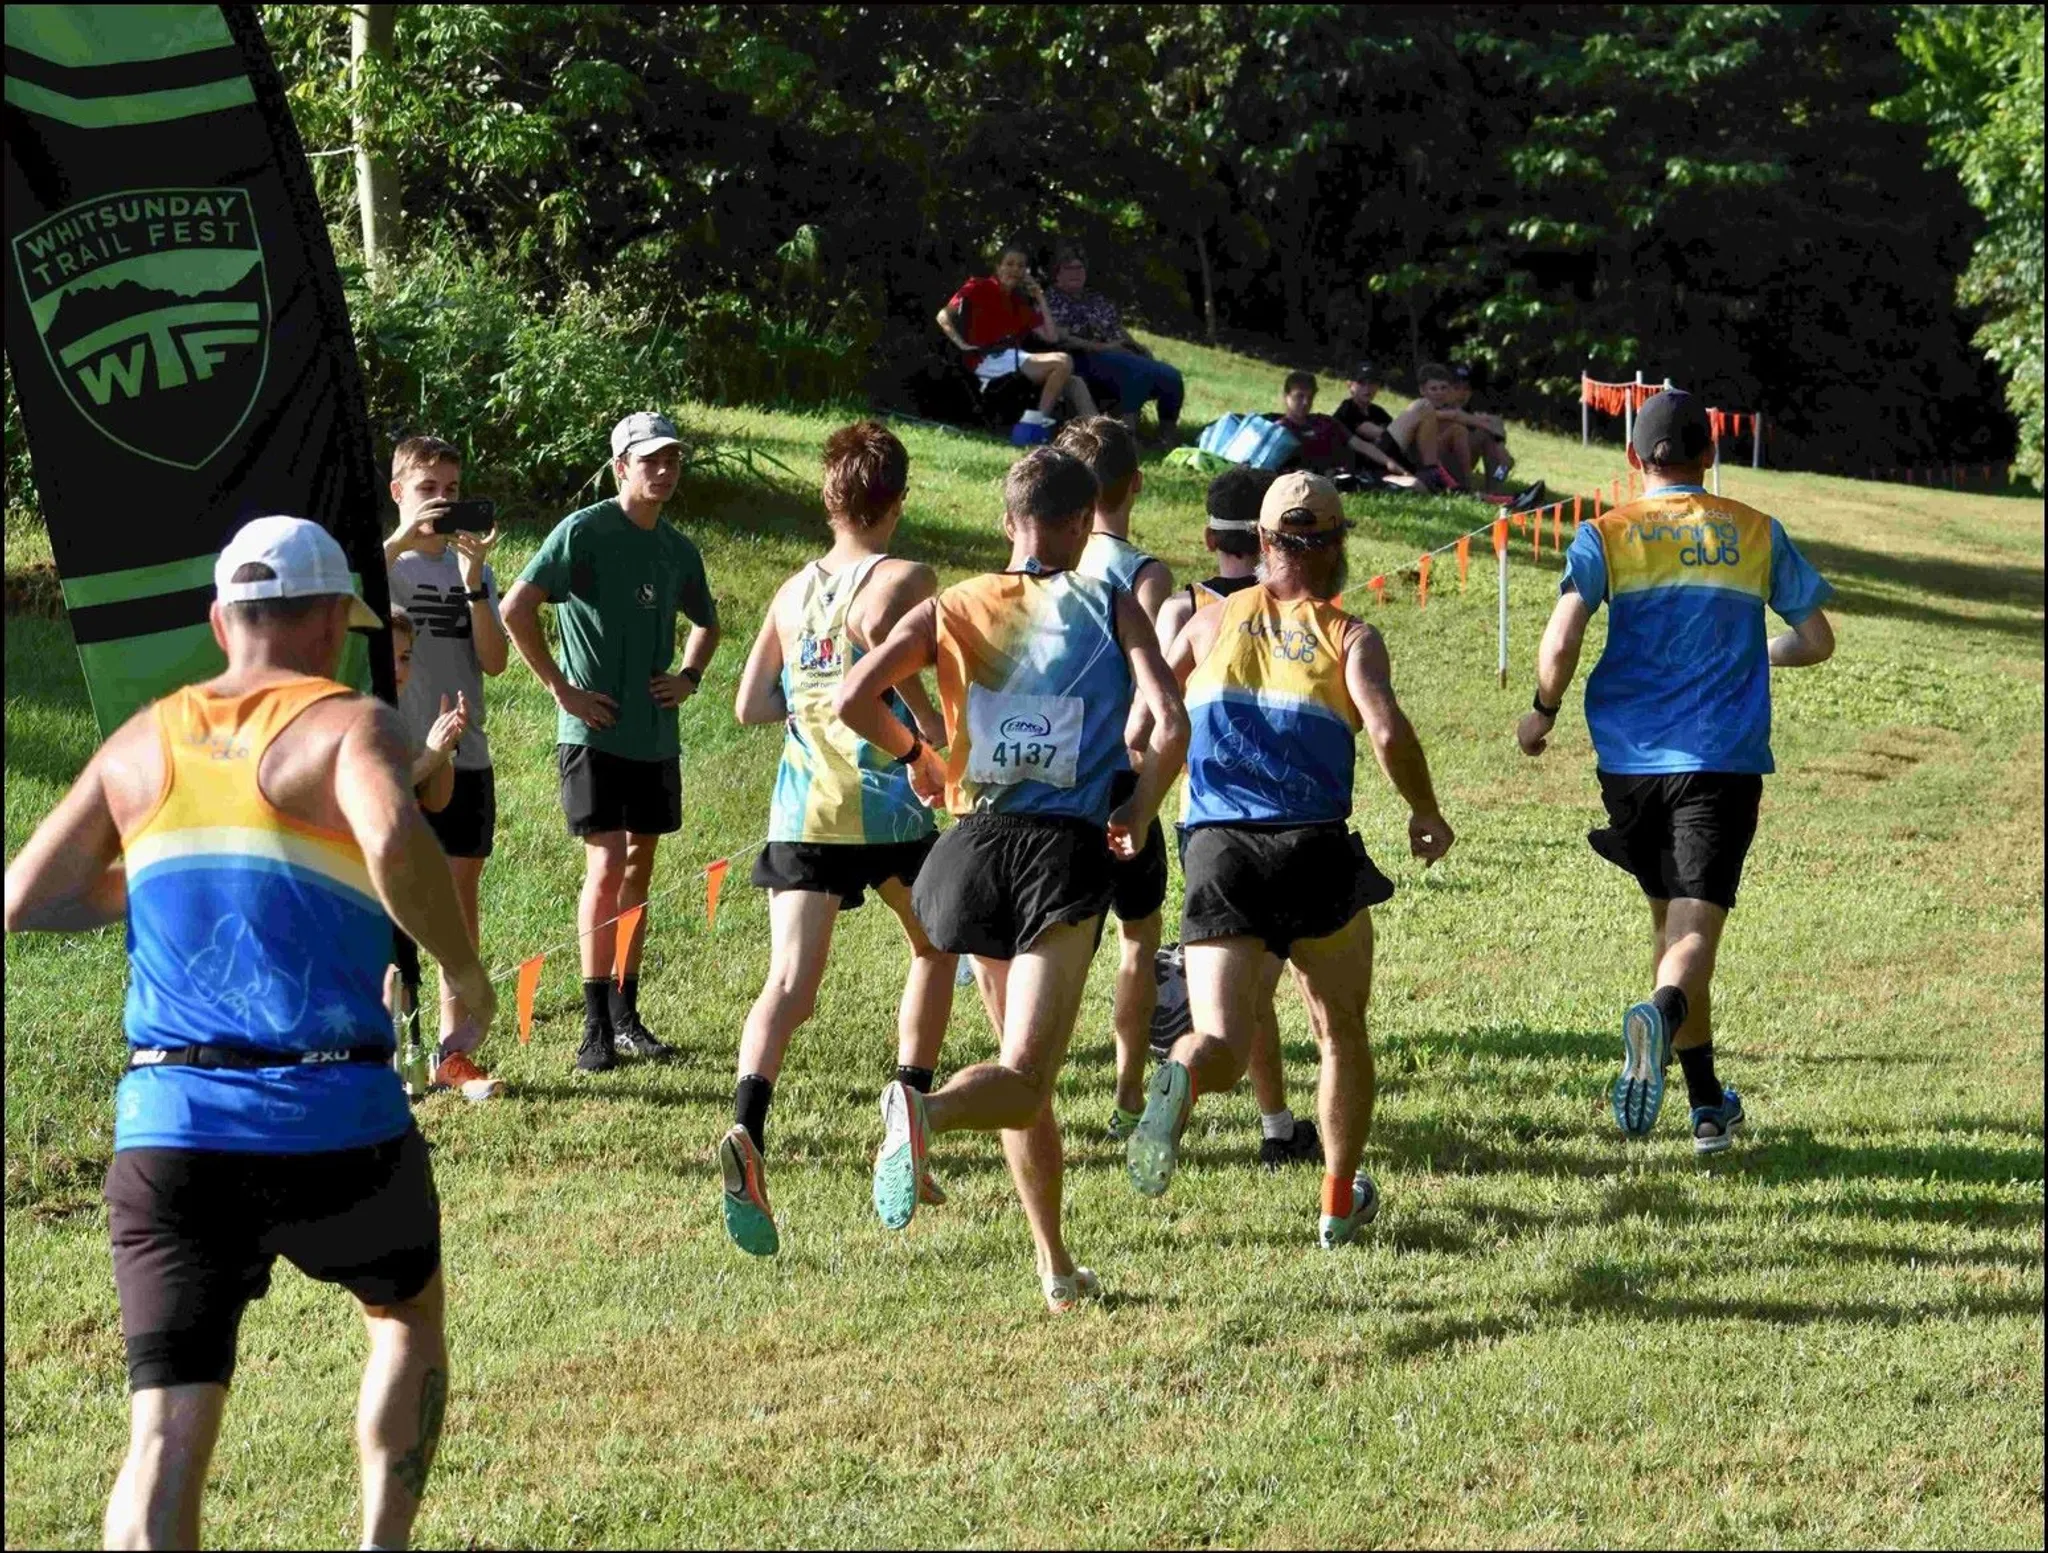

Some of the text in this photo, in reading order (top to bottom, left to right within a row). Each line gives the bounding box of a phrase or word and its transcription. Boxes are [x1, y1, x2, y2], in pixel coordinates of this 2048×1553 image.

[26, 196, 236, 260] WHITSUNDAY
[32, 221, 240, 286] TRAIL FEST
[60, 302, 260, 405] WTF
[1630, 522, 1738, 547] running
[1679, 540, 1740, 567] club
[1239, 615, 1318, 649] running
[1274, 645, 1315, 664] club
[992, 741, 1058, 769] 4137
[301, 1050, 350, 1064] 2XU
